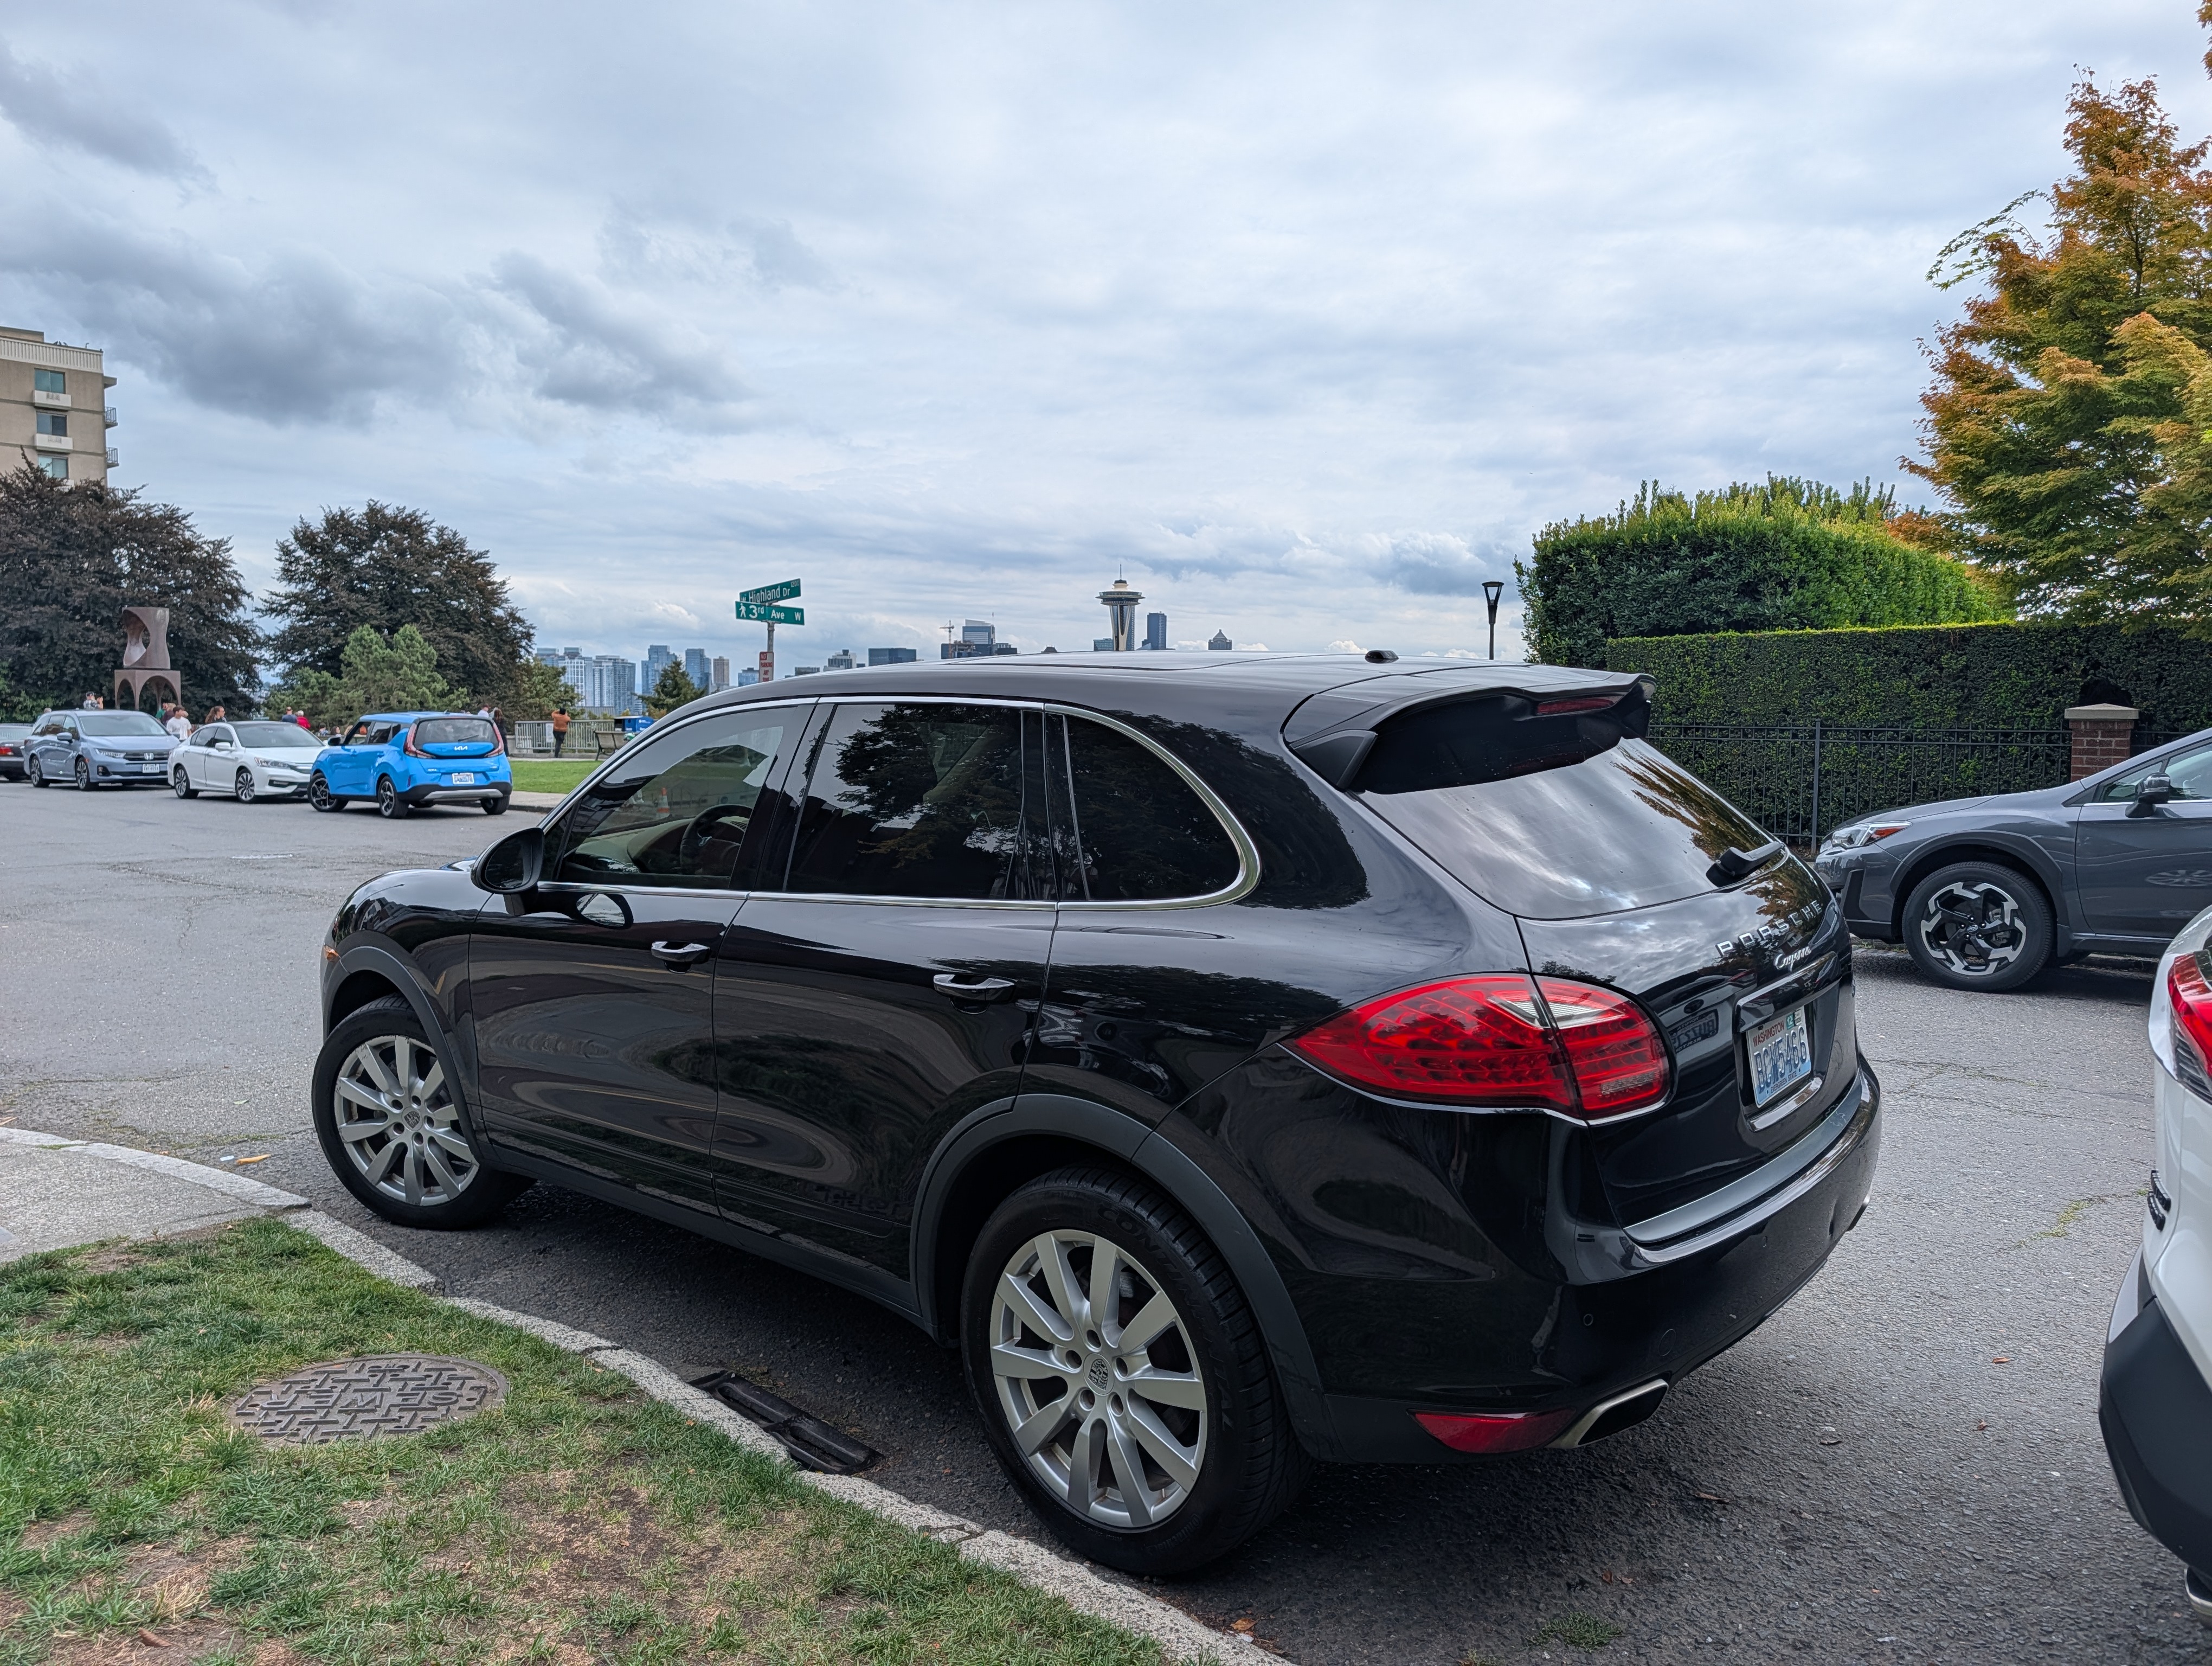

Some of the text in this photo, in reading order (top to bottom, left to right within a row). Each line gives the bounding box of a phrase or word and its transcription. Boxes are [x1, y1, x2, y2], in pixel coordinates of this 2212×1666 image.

[749, 585, 781, 603] Highland
[783, 587, 790, 597] Dr
[749, 605, 801, 621] 3rd Ave W
[1715, 900, 1823, 957] PORSCHE
[1773, 946, 1812, 972] Cayenne
[1787, 1015, 1793, 1026] 12
[1752, 1020, 1785, 1047] WASHINGTON
[1770, 1070, 1797, 1094] EVERGREEN STATE
[260, 1390, 463, 1409] SEWER
